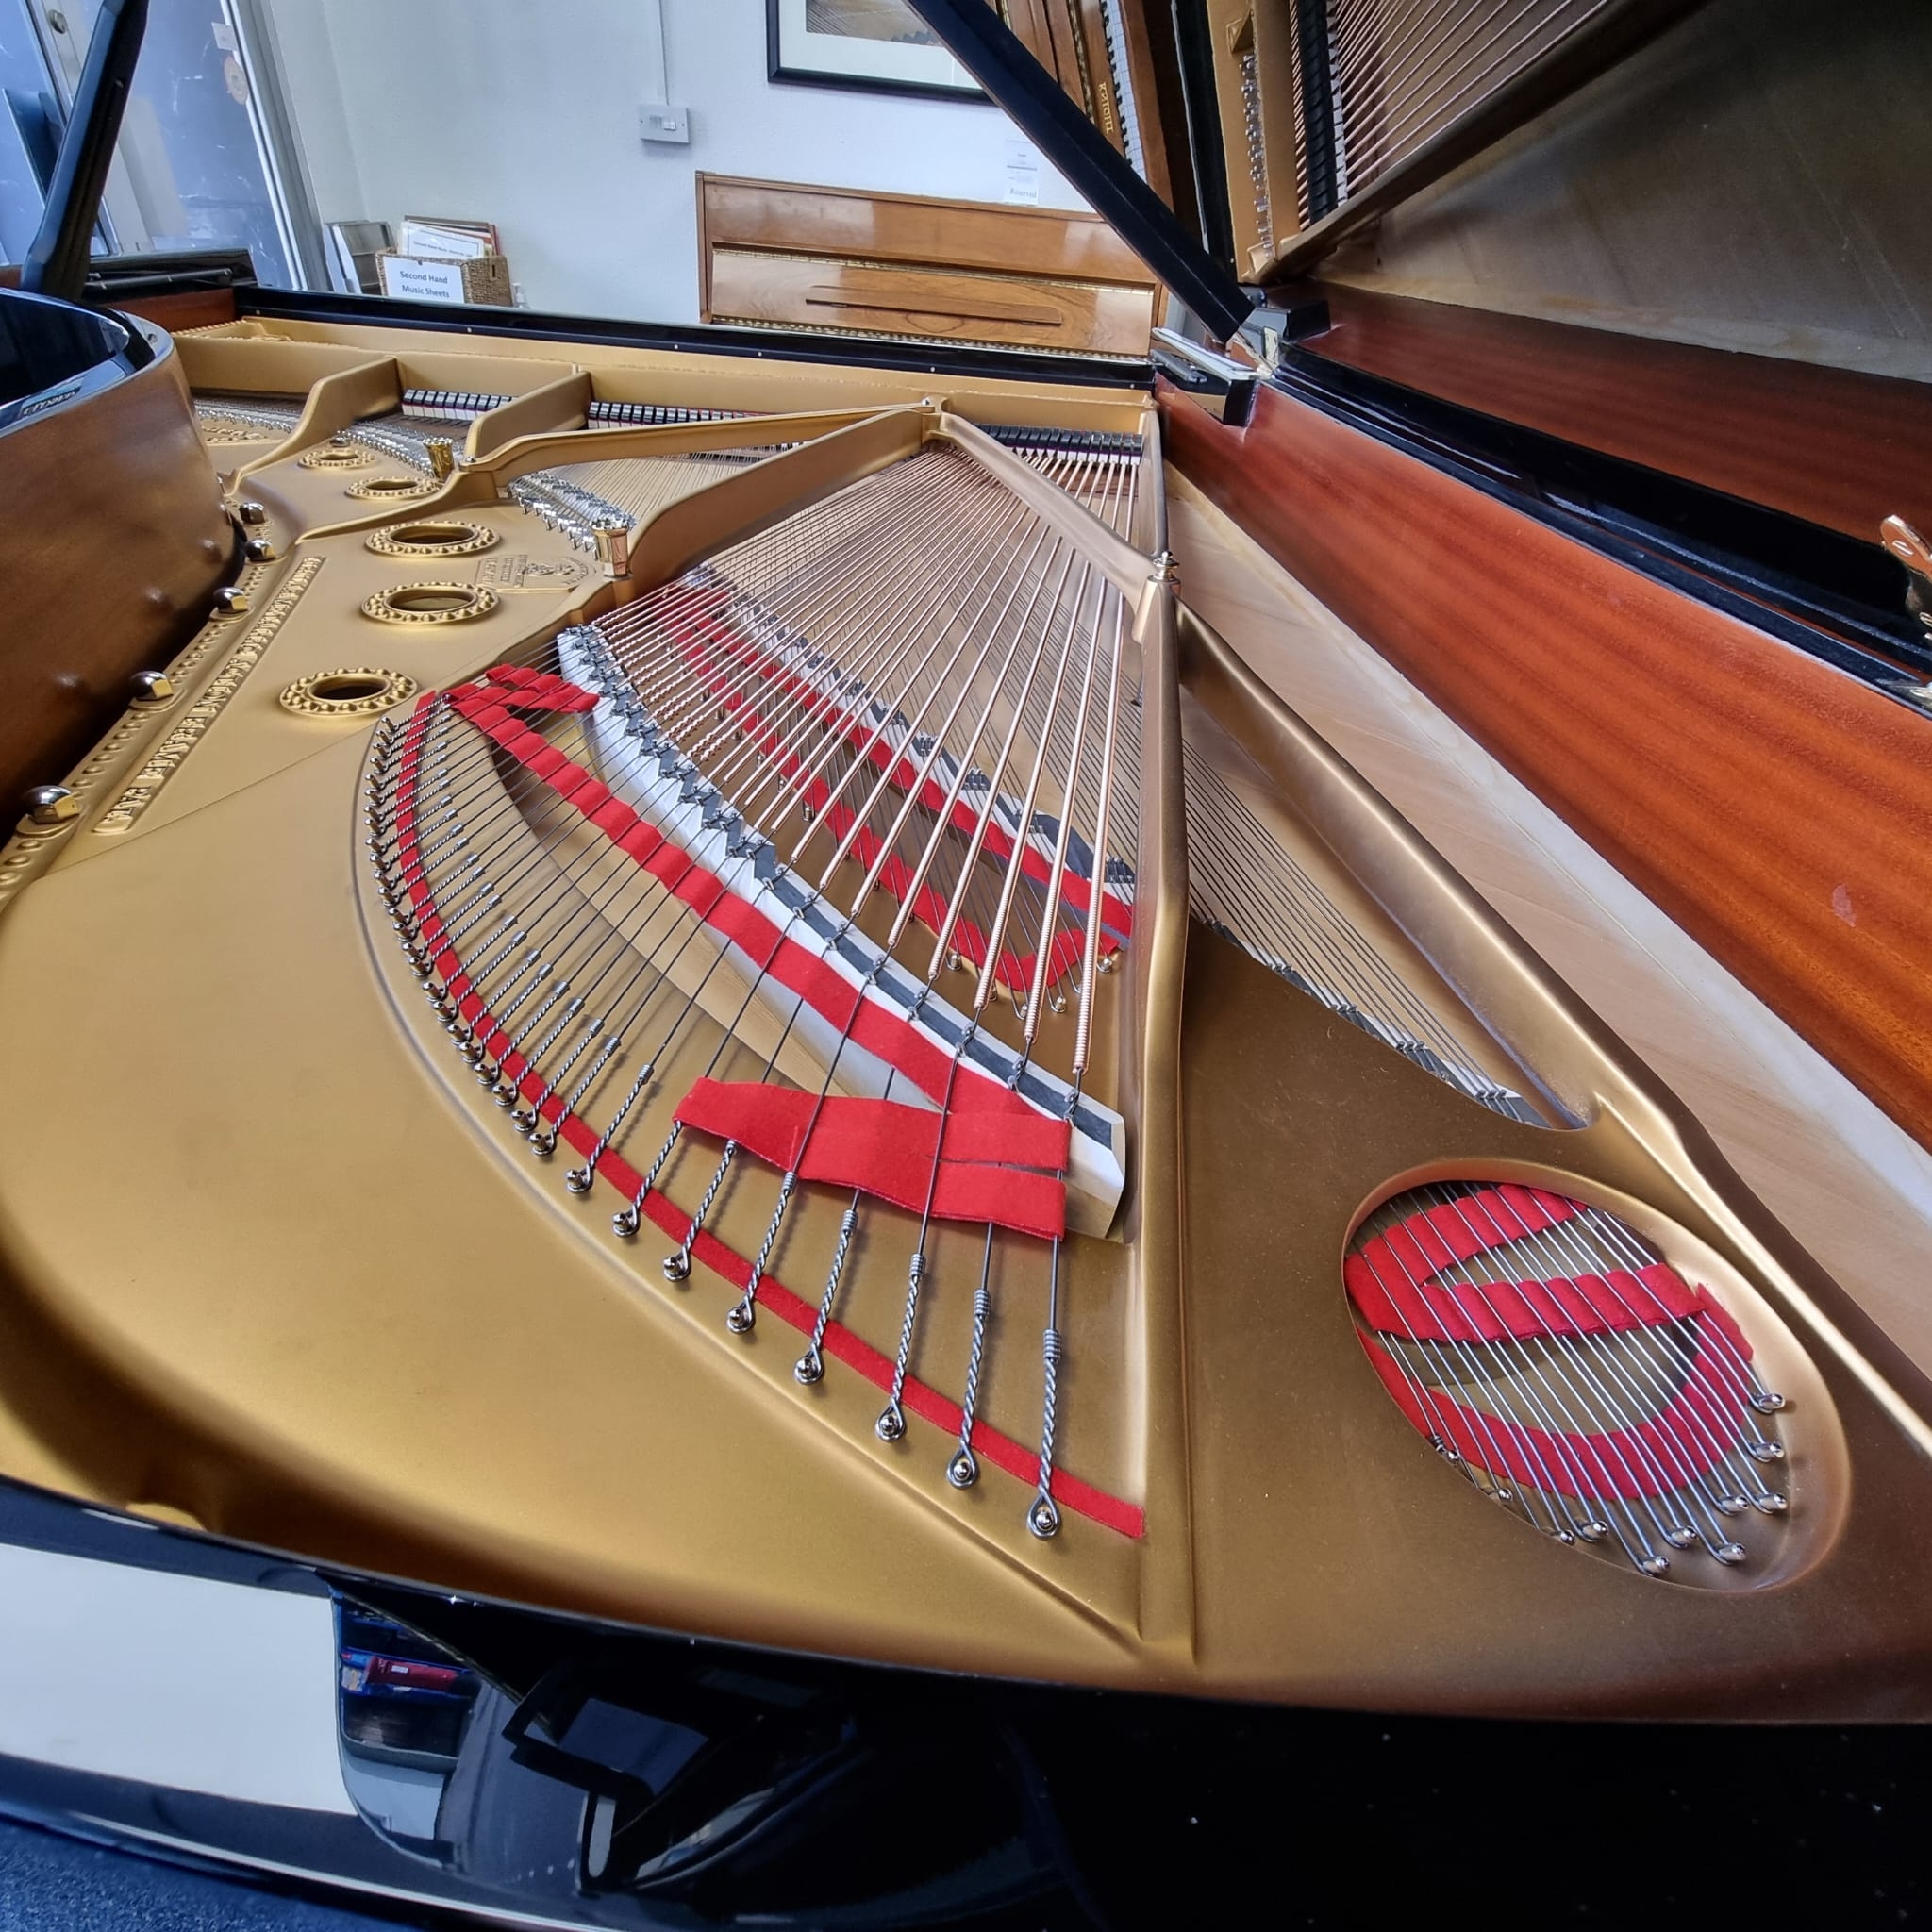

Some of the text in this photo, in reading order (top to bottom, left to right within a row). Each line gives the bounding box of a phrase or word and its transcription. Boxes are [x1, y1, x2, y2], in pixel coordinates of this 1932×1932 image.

[1009, 188, 1037, 198] Reserved
[400, 270, 448, 284] Second Hand
[402, 285, 450, 298] Music Sheets
[139, 717, 207, 776] FRAME
